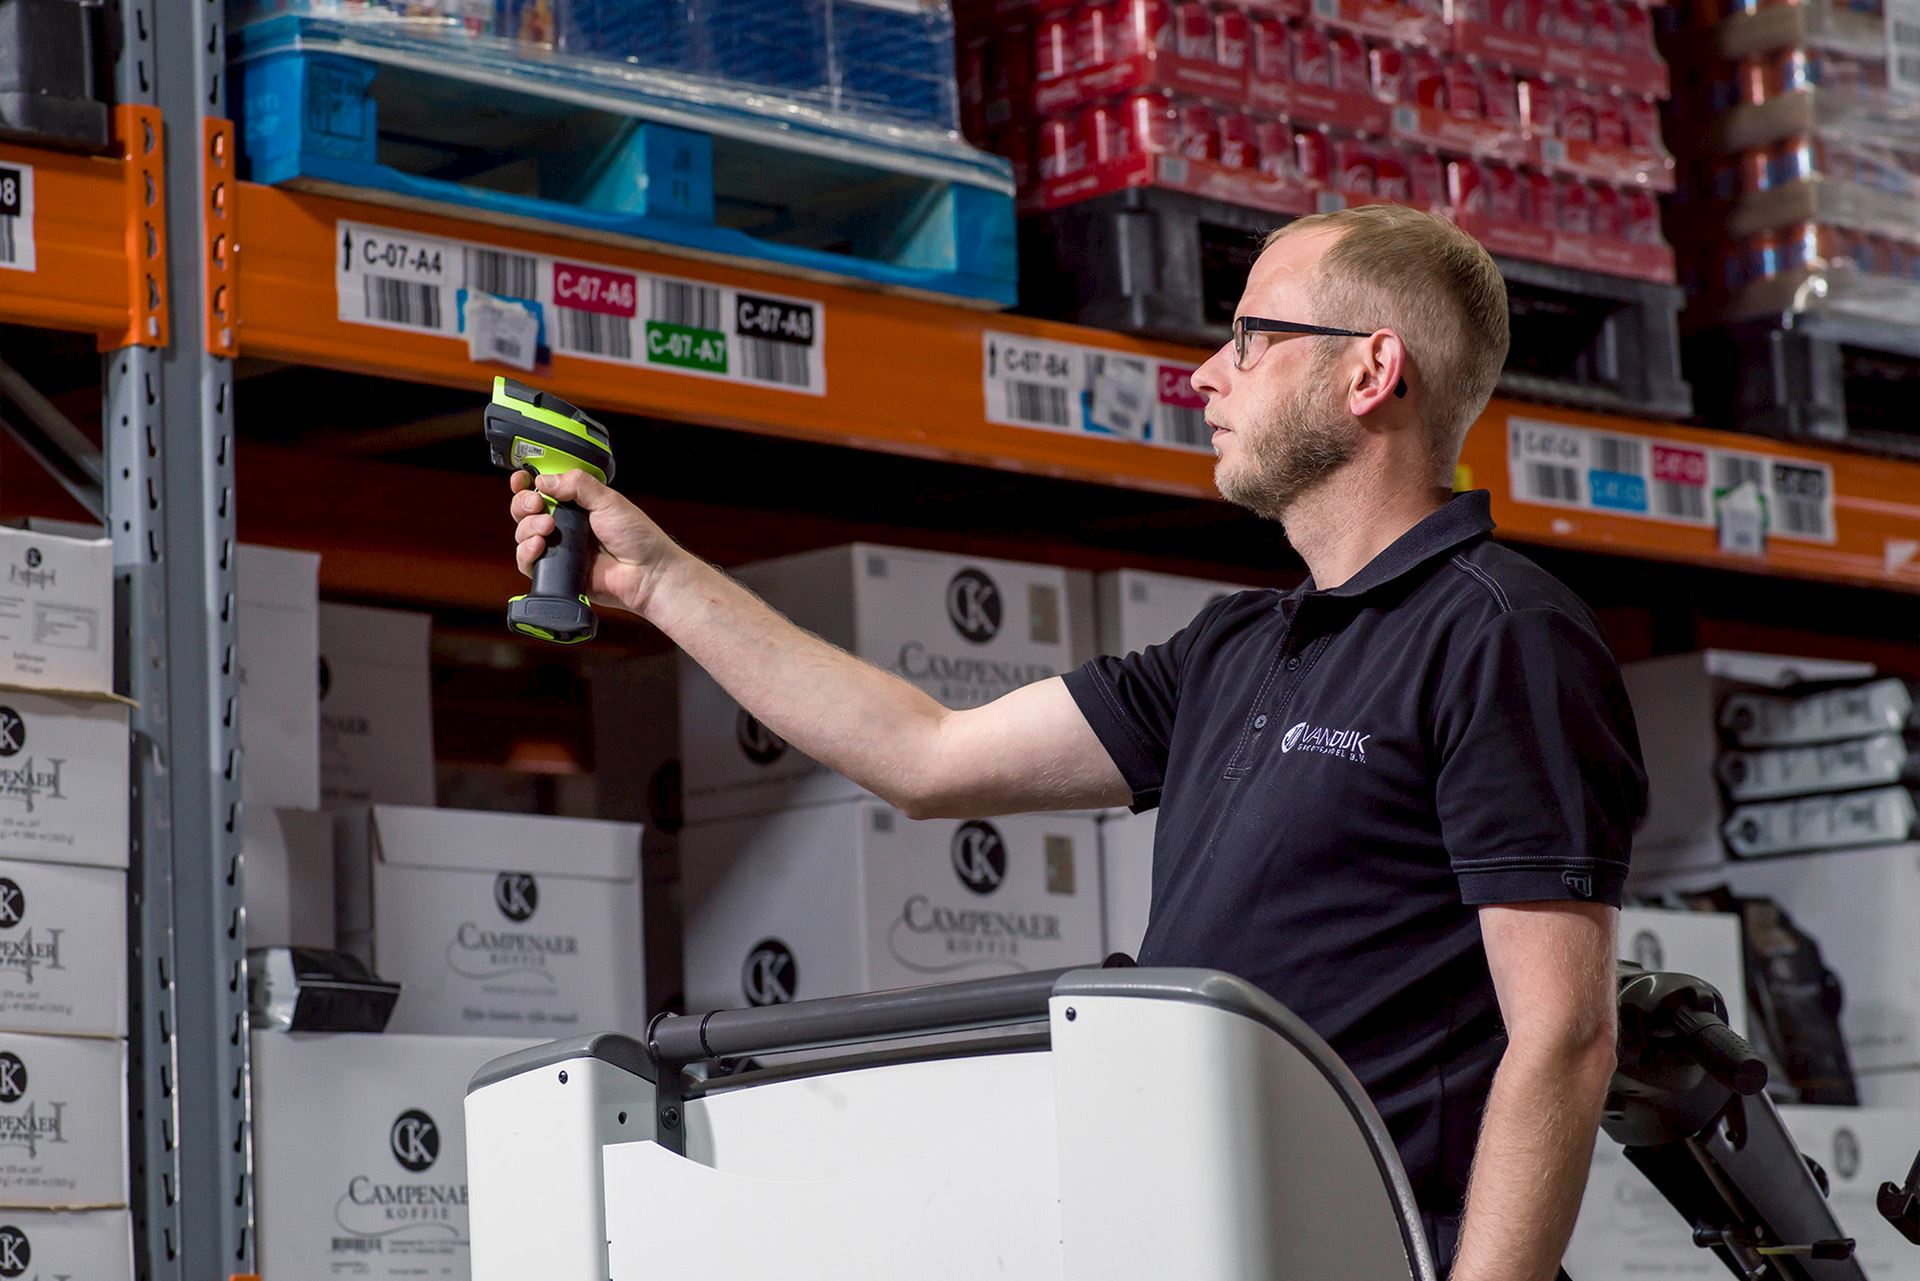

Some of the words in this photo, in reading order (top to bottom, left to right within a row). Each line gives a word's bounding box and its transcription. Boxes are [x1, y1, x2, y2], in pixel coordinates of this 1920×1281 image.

[0, 176, 17, 207] 8
[362, 239, 443, 274] C-07-A4
[648, 329, 726, 364] C-07-A7
